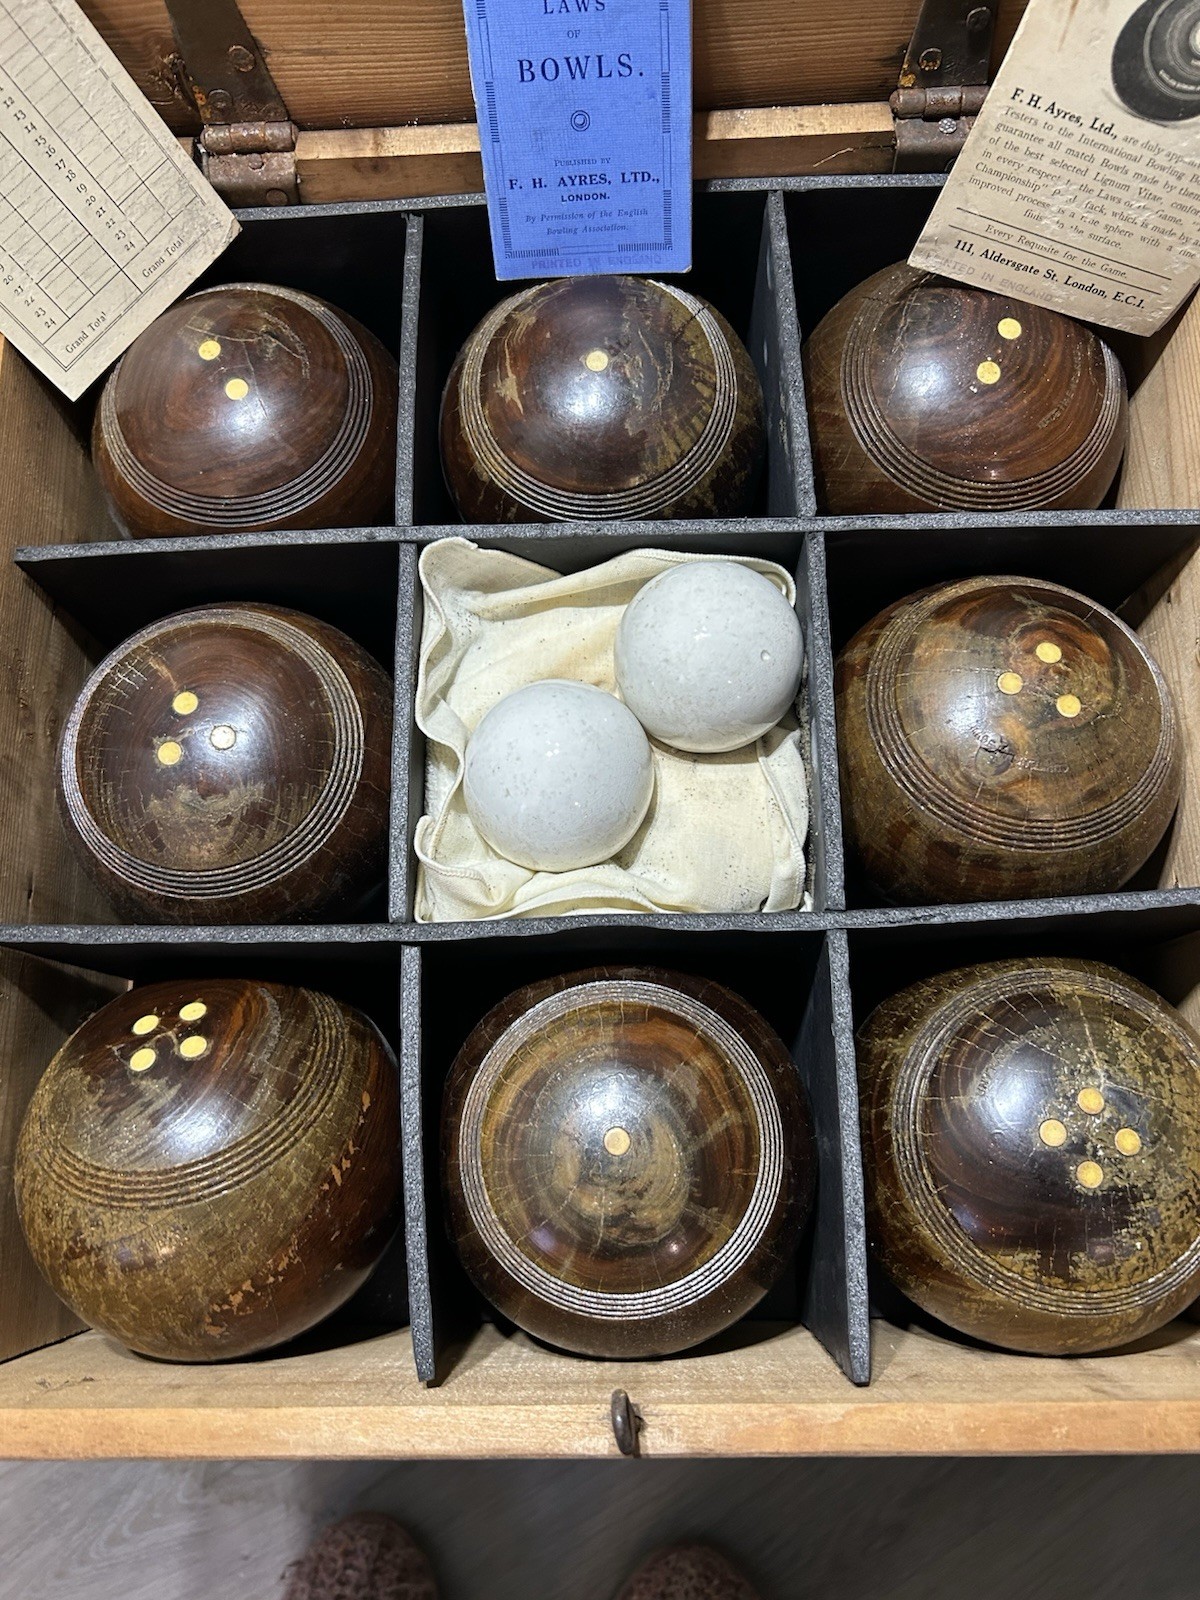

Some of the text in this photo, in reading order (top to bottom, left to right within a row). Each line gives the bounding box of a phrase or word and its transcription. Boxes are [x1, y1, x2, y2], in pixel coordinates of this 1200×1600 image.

[543, 0, 606, 15] LAWS
[566, 29, 581, 39] OF
[517, 53, 644, 83] BOWLS.
[3, 96, 15, 109] 12
[13, 109, 27, 121] 13
[1010, 87, 1024, 103] F.
[1026, 93, 1042, 110] H.
[1044, 101, 1084, 127] Ayres,
[1089, 117, 1118, 140] Ltd.,
[1122, 135, 1140, 147] are
[1141, 140, 1165, 156] duly
[24, 121, 38, 133] 14
[34, 134, 47, 146] 15
[1004, 105, 1039, 126] Testers
[1043, 121, 1054, 131] to
[1058, 127, 1075, 139] the
[1078, 133, 1143, 164] International
[1146, 157, 1186, 180] Bowling
[45, 144, 56, 158] 16
[994, 122, 1046, 144] guarantee
[1047, 140, 1063, 151] all
[1065, 148, 1096, 164] match
[1100, 158, 1130, 175] Bowls
[1133, 172, 1160, 185] made
[1162, 180, 1178, 193] by
[54, 158, 67, 170] 17
[989, 136, 1001, 145] of
[1003, 140, 1020, 152] the
[1024, 146, 1045, 161] best
[1049, 159, 1089, 177] selected
[1093, 172, 1131, 192] Lignum
[1138, 187, 1164, 205] Vitae,
[65, 169, 77, 182] 18
[508, 171, 660, 190] F. H. AYRES, LTD.,
[982, 148, 993, 159] in
[996, 155, 1024, 170] every
[1079, 183, 1095, 195] the
[1097, 189, 1122, 204] Laws
[76, 183, 88, 194] 19
[85, 195, 97, 207] 20
[561, 192, 610, 203] LONDON.
[95, 206, 107, 218] 21
[525, 208, 648, 224] By Permission of the English
[968, 175, 1015, 197] improved
[1069, 211, 1076, 219] a
[1103, 223, 1135, 238] sphere
[1140, 235, 1161, 248] with
[105, 218, 117, 229] 22
[114, 229, 127, 241] 23
[546, 226, 579, 236] Bowling
[1140, 219, 1150, 229] is
[1151, 225, 1177, 238] made
[1178, 232, 1194, 245] by
[123, 241, 136, 252] 24
[1088, 232, 1122, 249] surface.
[141, 235, 185, 278] Grand Total
[984, 224, 1127, 279] Every Requisite for the Game.
[3, 274, 14, 286] 20
[955, 239, 1145, 309] 111, Aldersgate St. London, E.C.1.
[981, 271, 996, 283] IN
[34, 307, 47, 318] 23
[44, 317, 57, 329] 24
[65, 331, 89, 354] Grand
